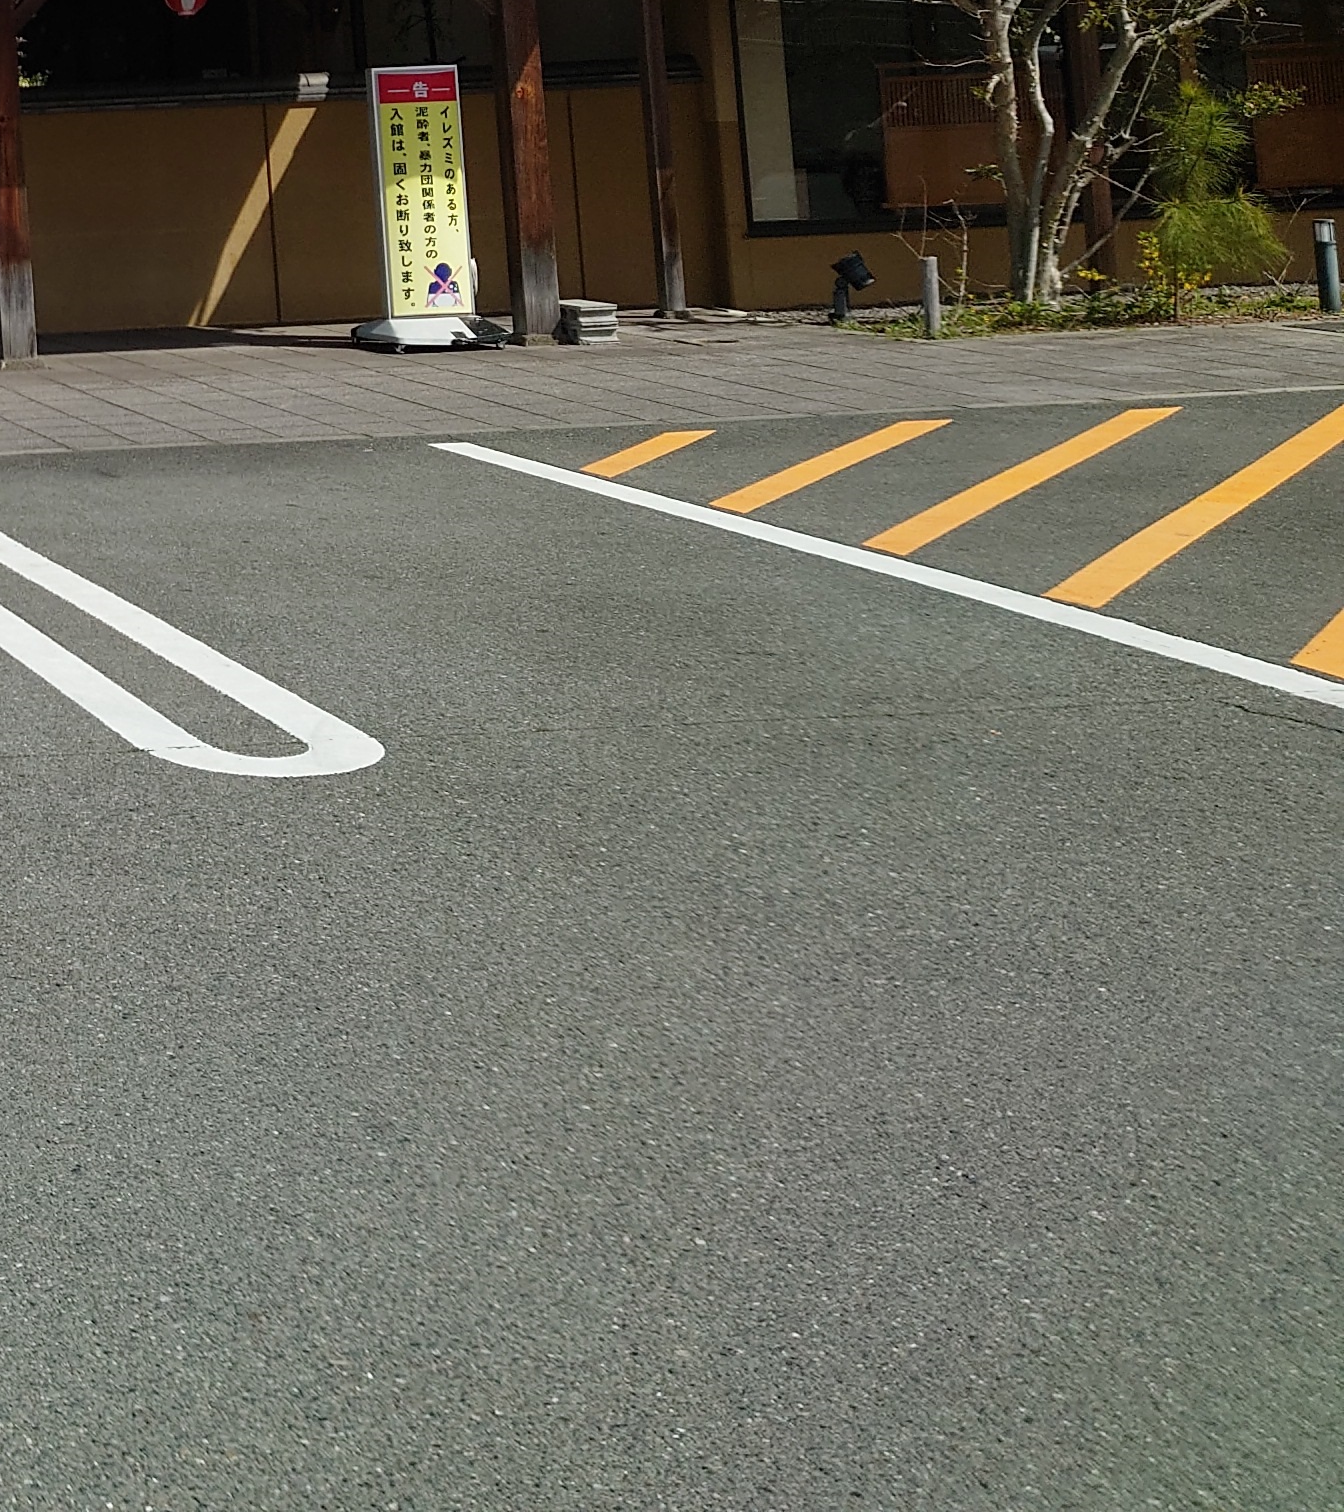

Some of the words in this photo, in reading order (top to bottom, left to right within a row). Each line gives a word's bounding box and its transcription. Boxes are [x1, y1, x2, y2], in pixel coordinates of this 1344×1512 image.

[389, 107, 416, 308] 入館は、固くお断り致します。
[439, 105, 460, 233] イレズミのある方、
